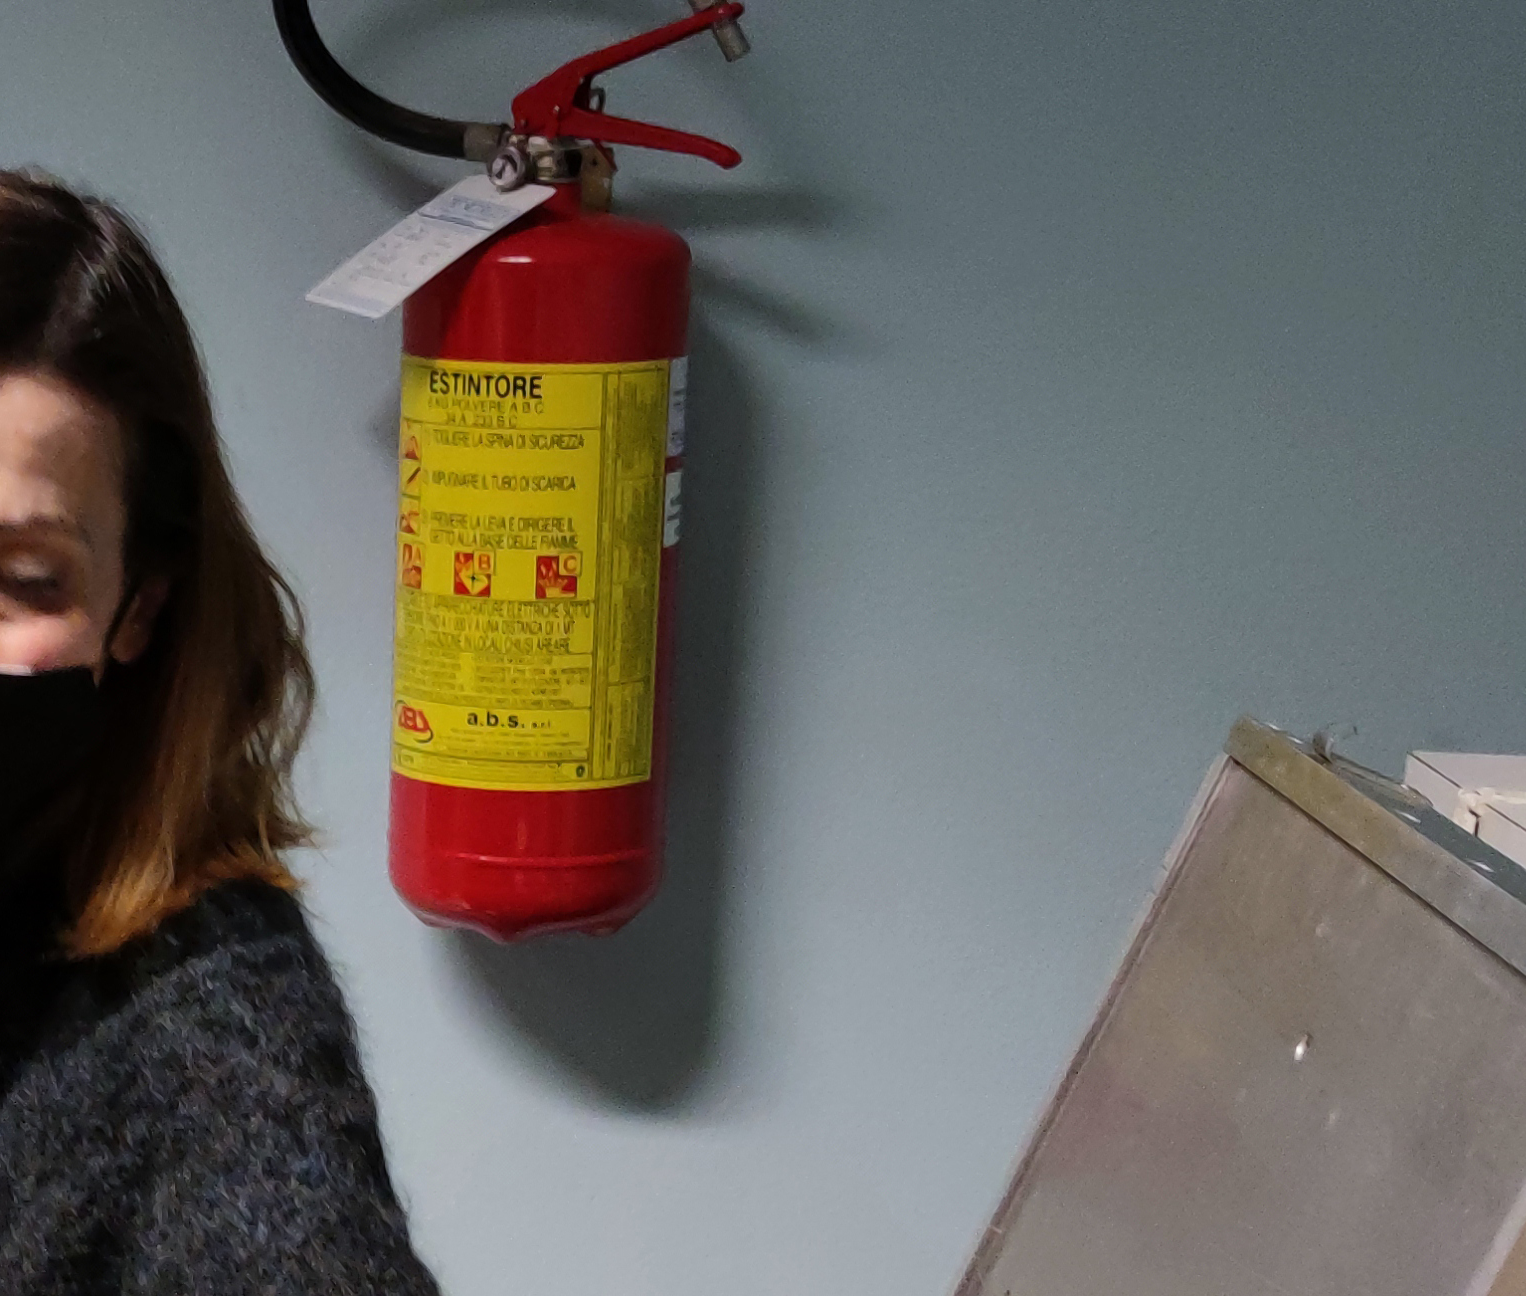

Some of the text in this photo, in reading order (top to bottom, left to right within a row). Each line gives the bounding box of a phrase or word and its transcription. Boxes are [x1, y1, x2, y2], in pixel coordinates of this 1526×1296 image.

[429, 370, 543, 399] ESTINTORE
[478, 553, 491, 570] B
[563, 555, 577, 572] C
